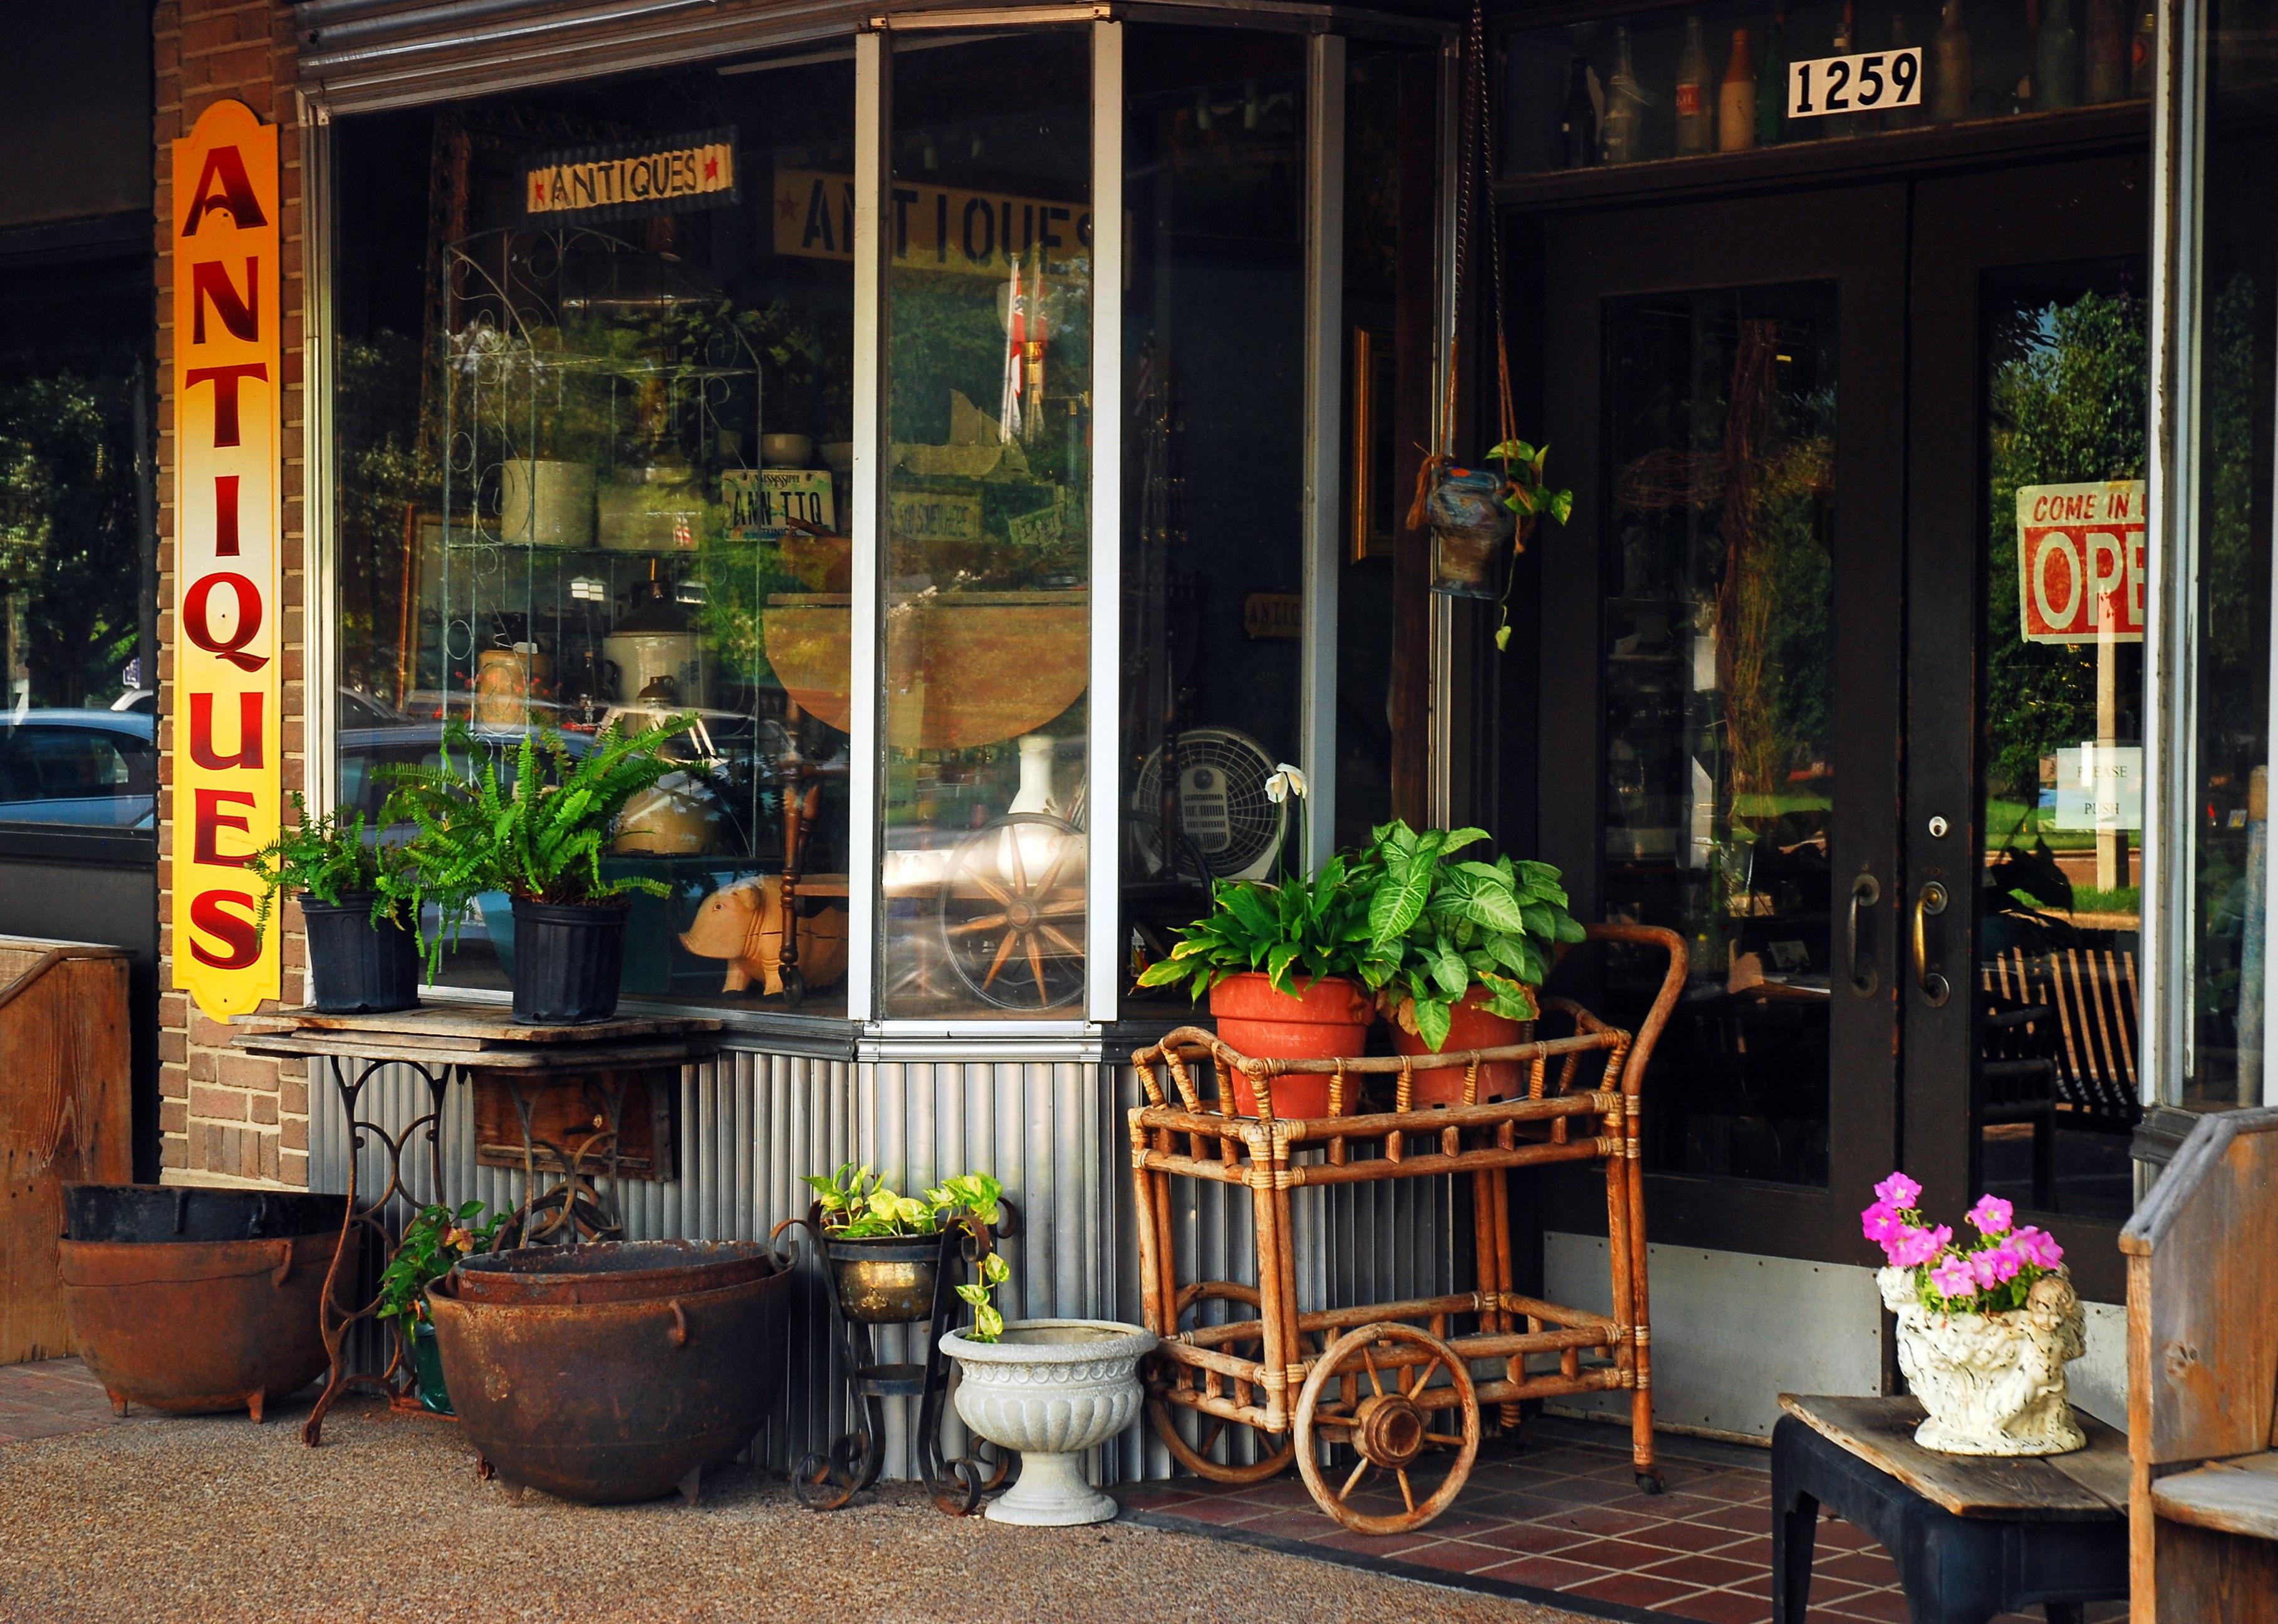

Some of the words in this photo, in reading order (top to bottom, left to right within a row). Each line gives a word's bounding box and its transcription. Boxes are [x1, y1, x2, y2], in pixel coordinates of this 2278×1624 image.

[1797, 53, 1917, 113] 1259
[551, 153, 697, 210] ANTIQUES
[733, 492, 771, 525] ANN
[2034, 494, 2097, 521] COME
[2108, 492, 2130, 519] IN
[182, 145, 271, 969] ANTIQUES
[2034, 531, 2145, 629] OPE
[2077, 766, 2128, 778] PEASE
[2084, 803, 2119, 815] PUSH
